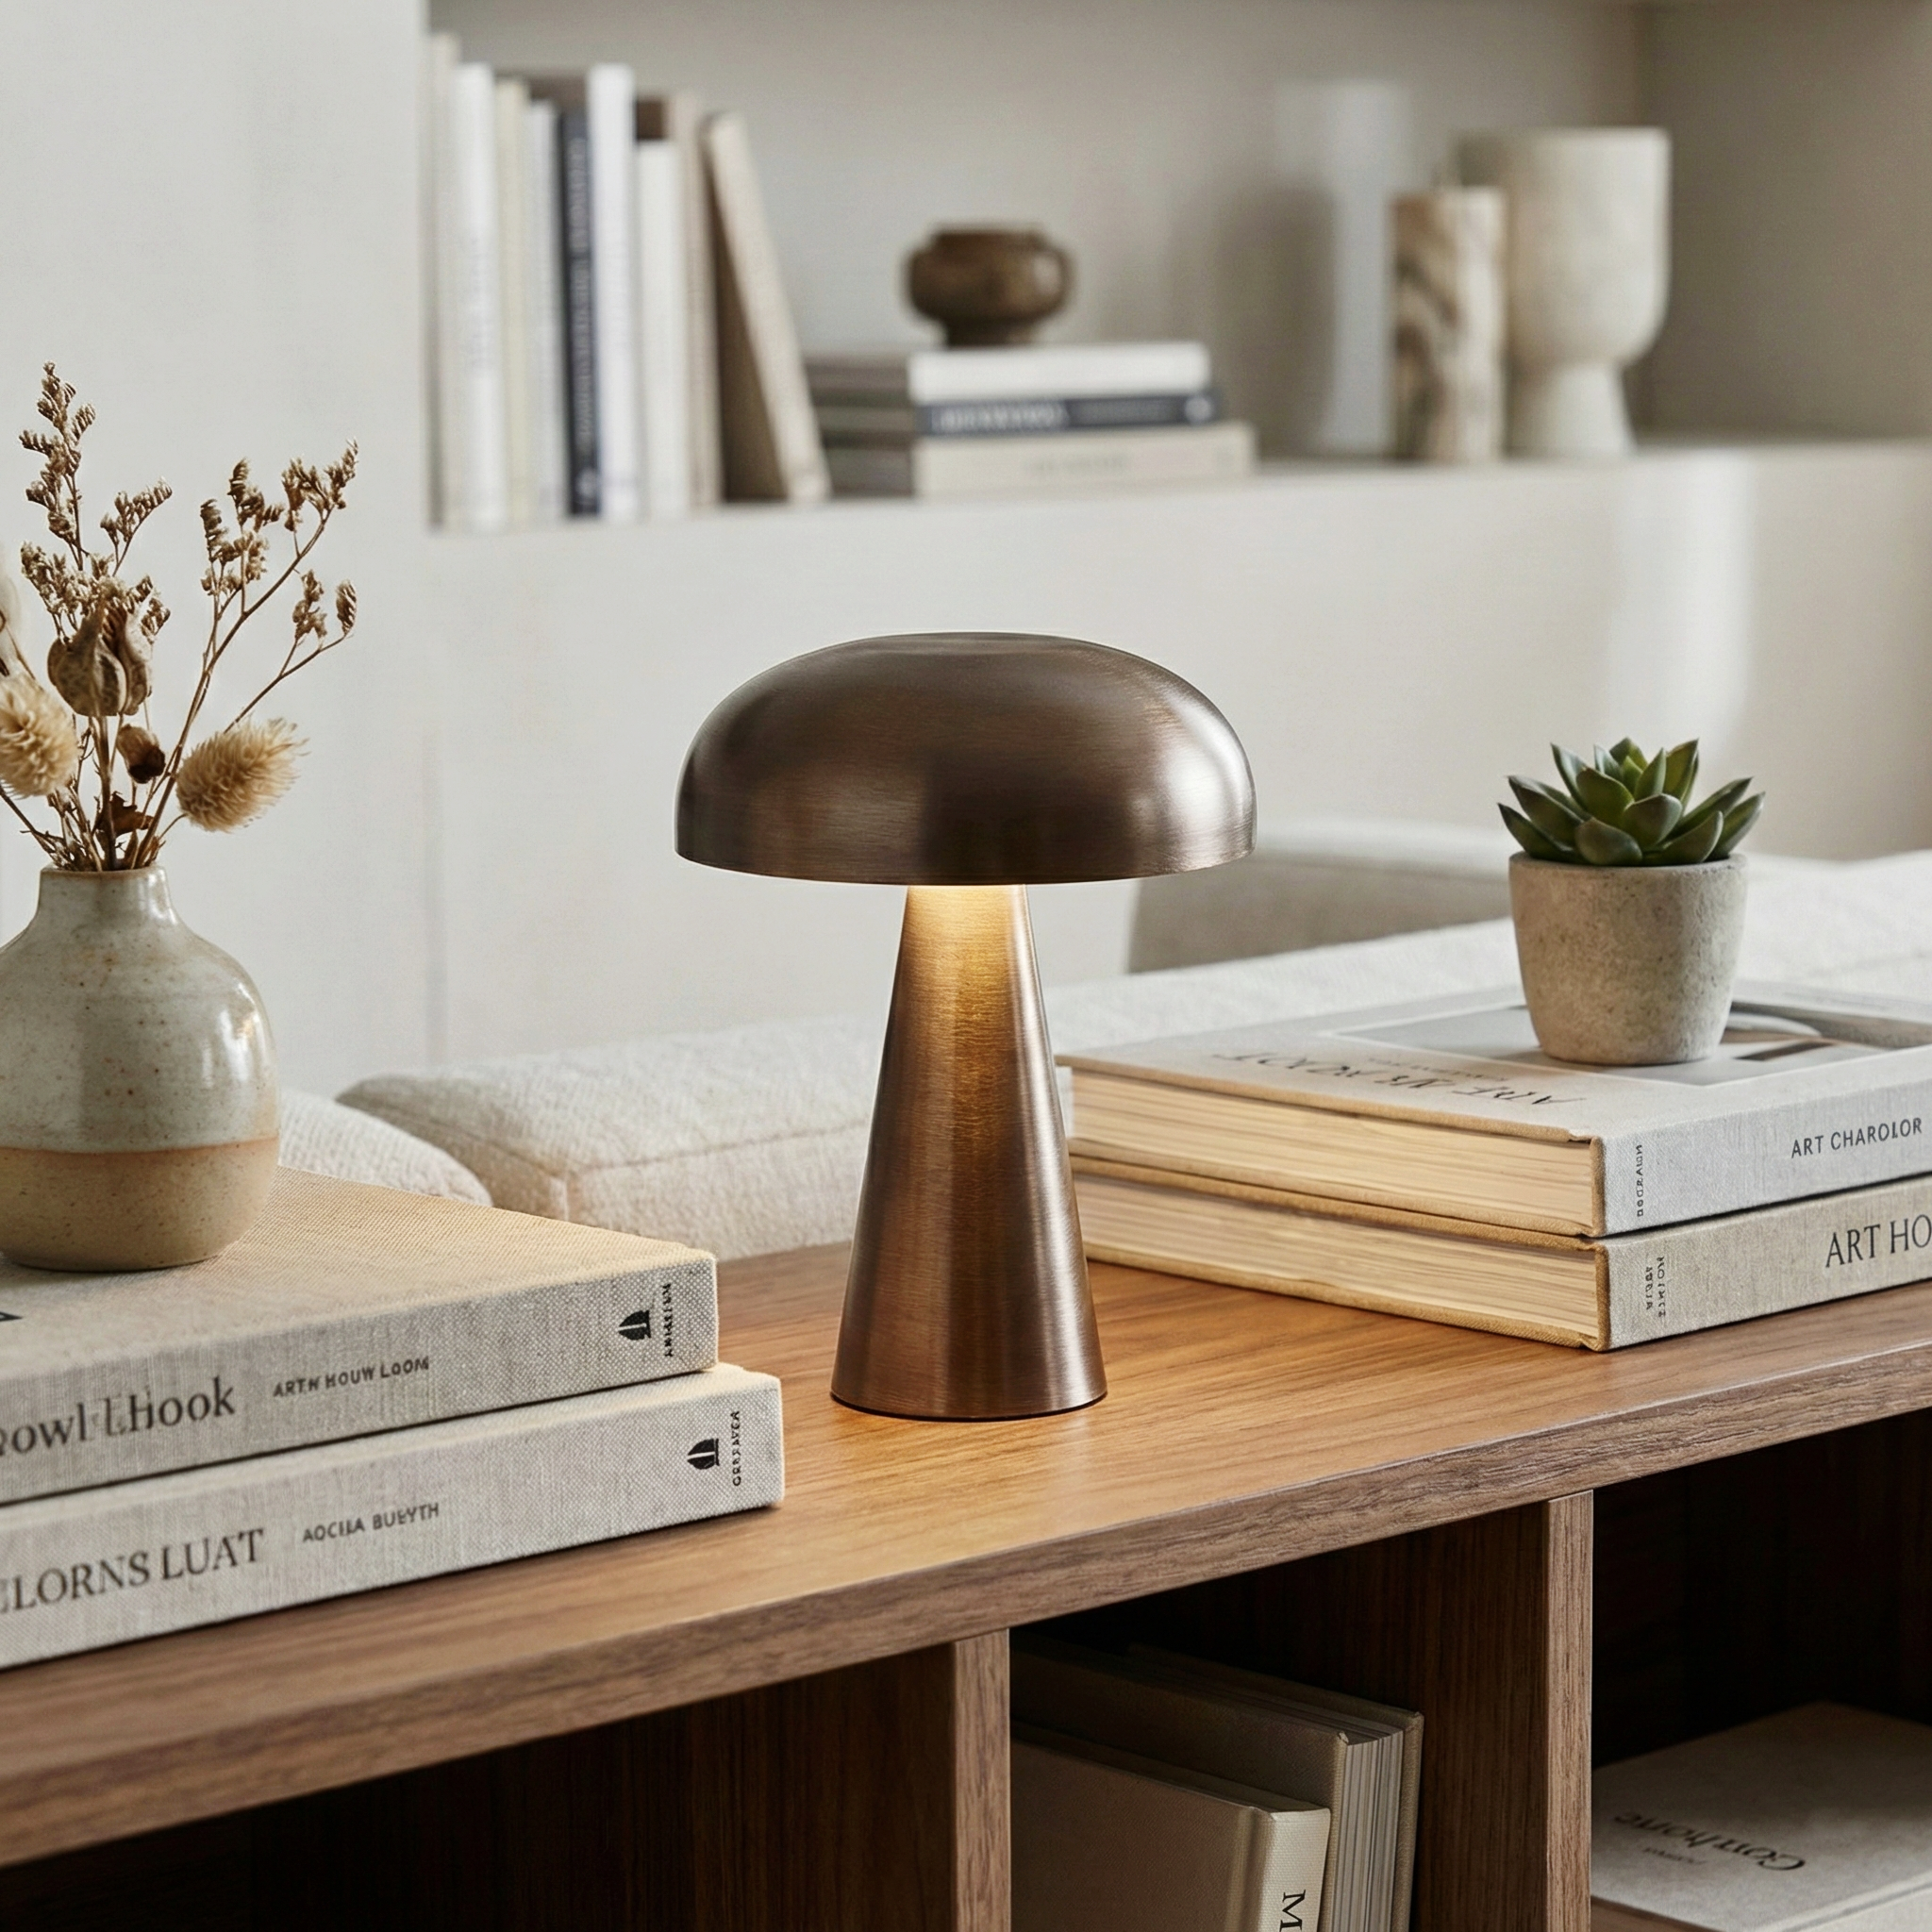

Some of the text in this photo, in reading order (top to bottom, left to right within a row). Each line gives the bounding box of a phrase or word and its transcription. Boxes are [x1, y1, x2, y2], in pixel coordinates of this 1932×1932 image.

[1791, 1135, 1824, 1158] ART
[1825, 1214, 1932, 1268] ART HO
[160, 1528, 264, 1580] LUAT
